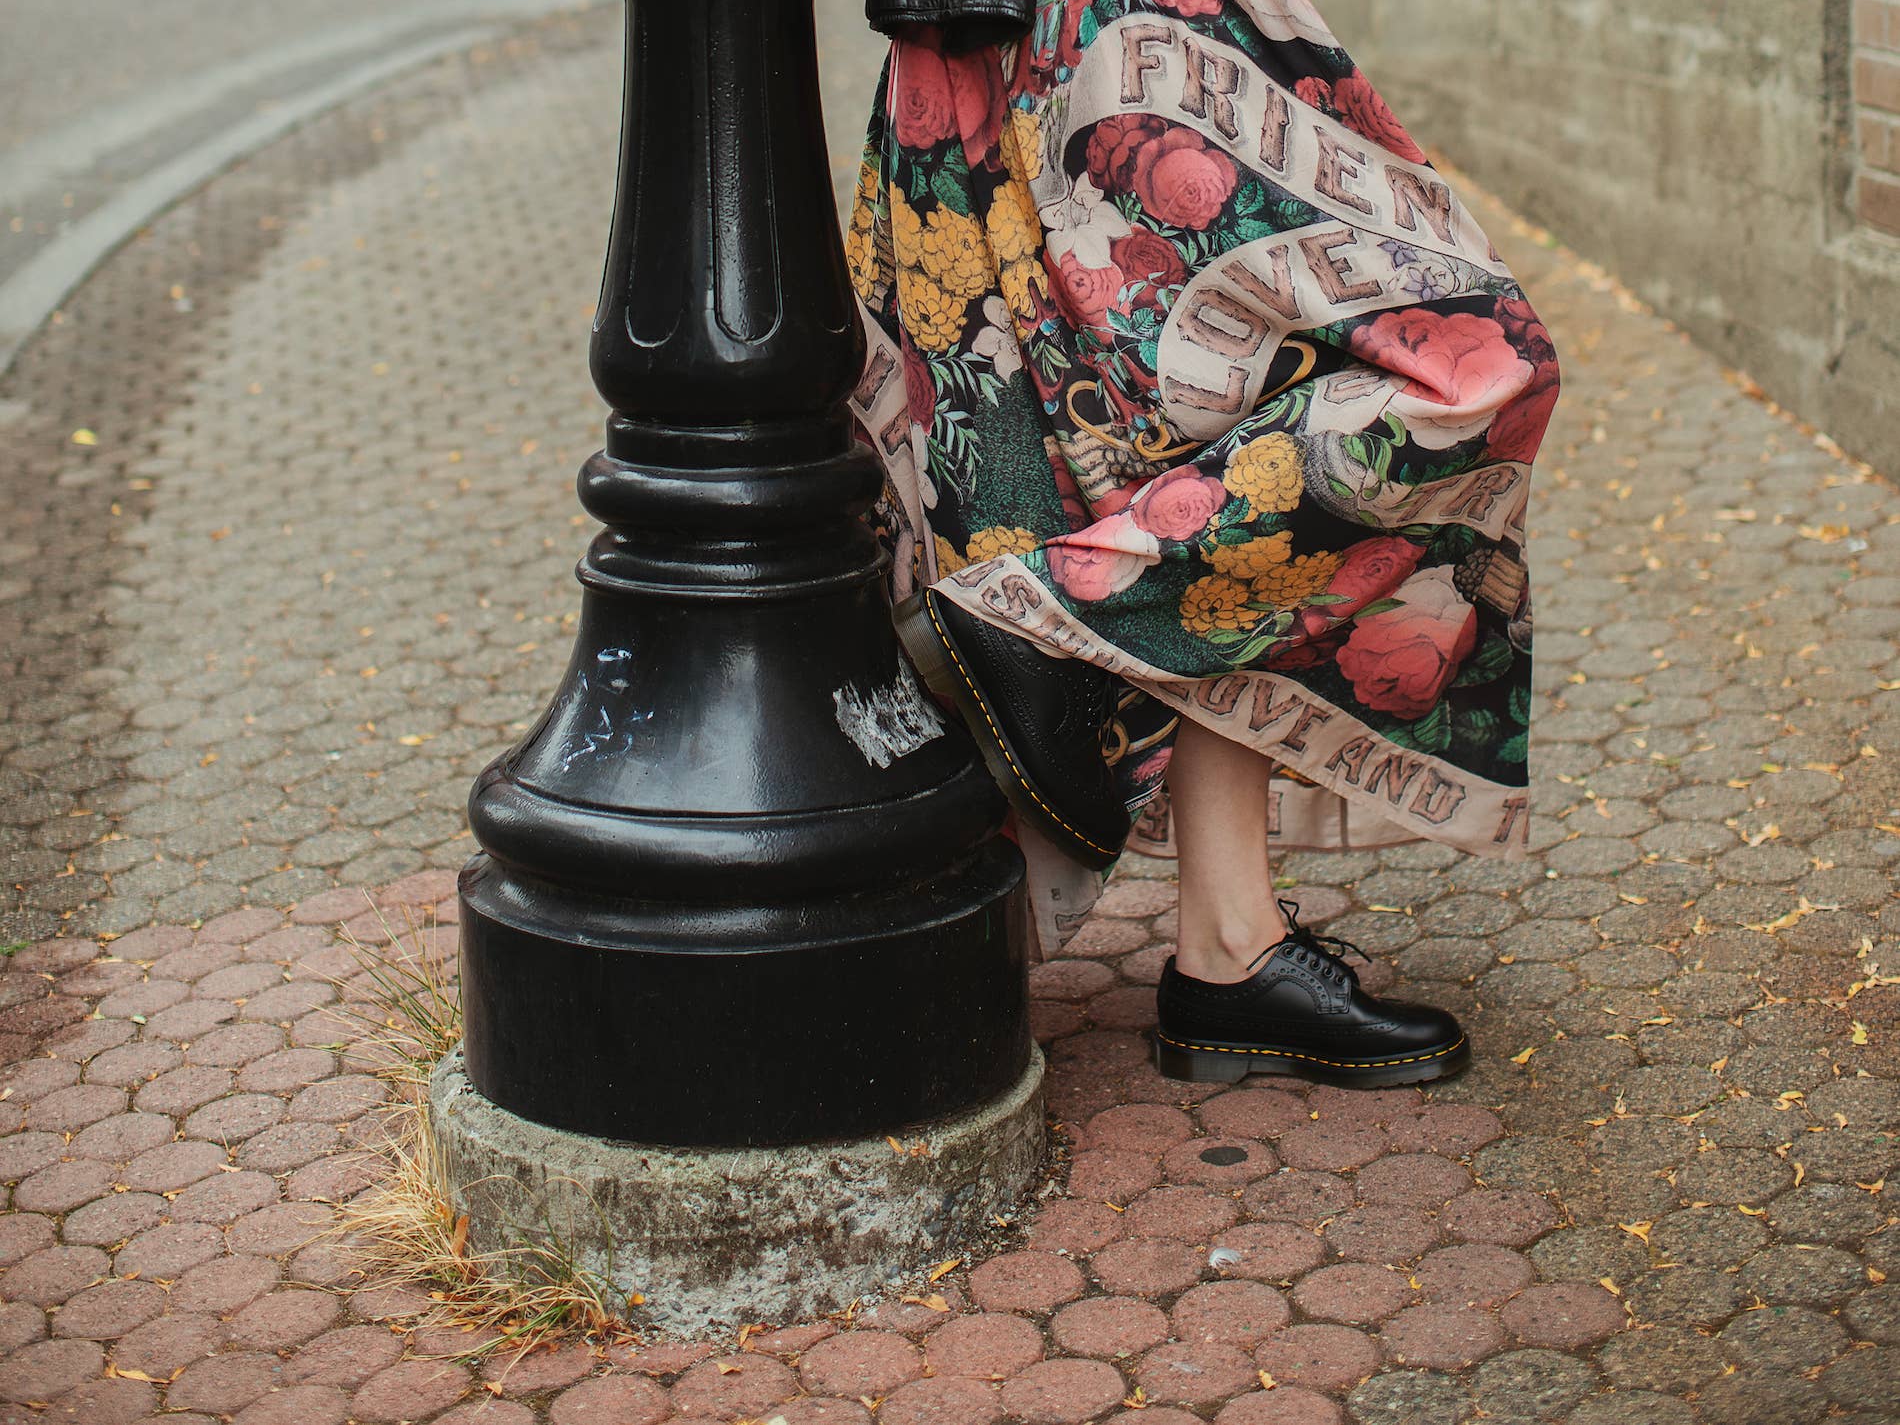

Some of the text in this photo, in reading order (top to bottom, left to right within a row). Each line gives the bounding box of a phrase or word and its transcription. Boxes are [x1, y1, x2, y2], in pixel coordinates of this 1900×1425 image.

[1118, 23, 1503, 262] FRIEN
[1164, 227, 1384, 415] LOVE
[1325, 735, 1466, 824] AND
[1493, 796, 1530, 844] T
